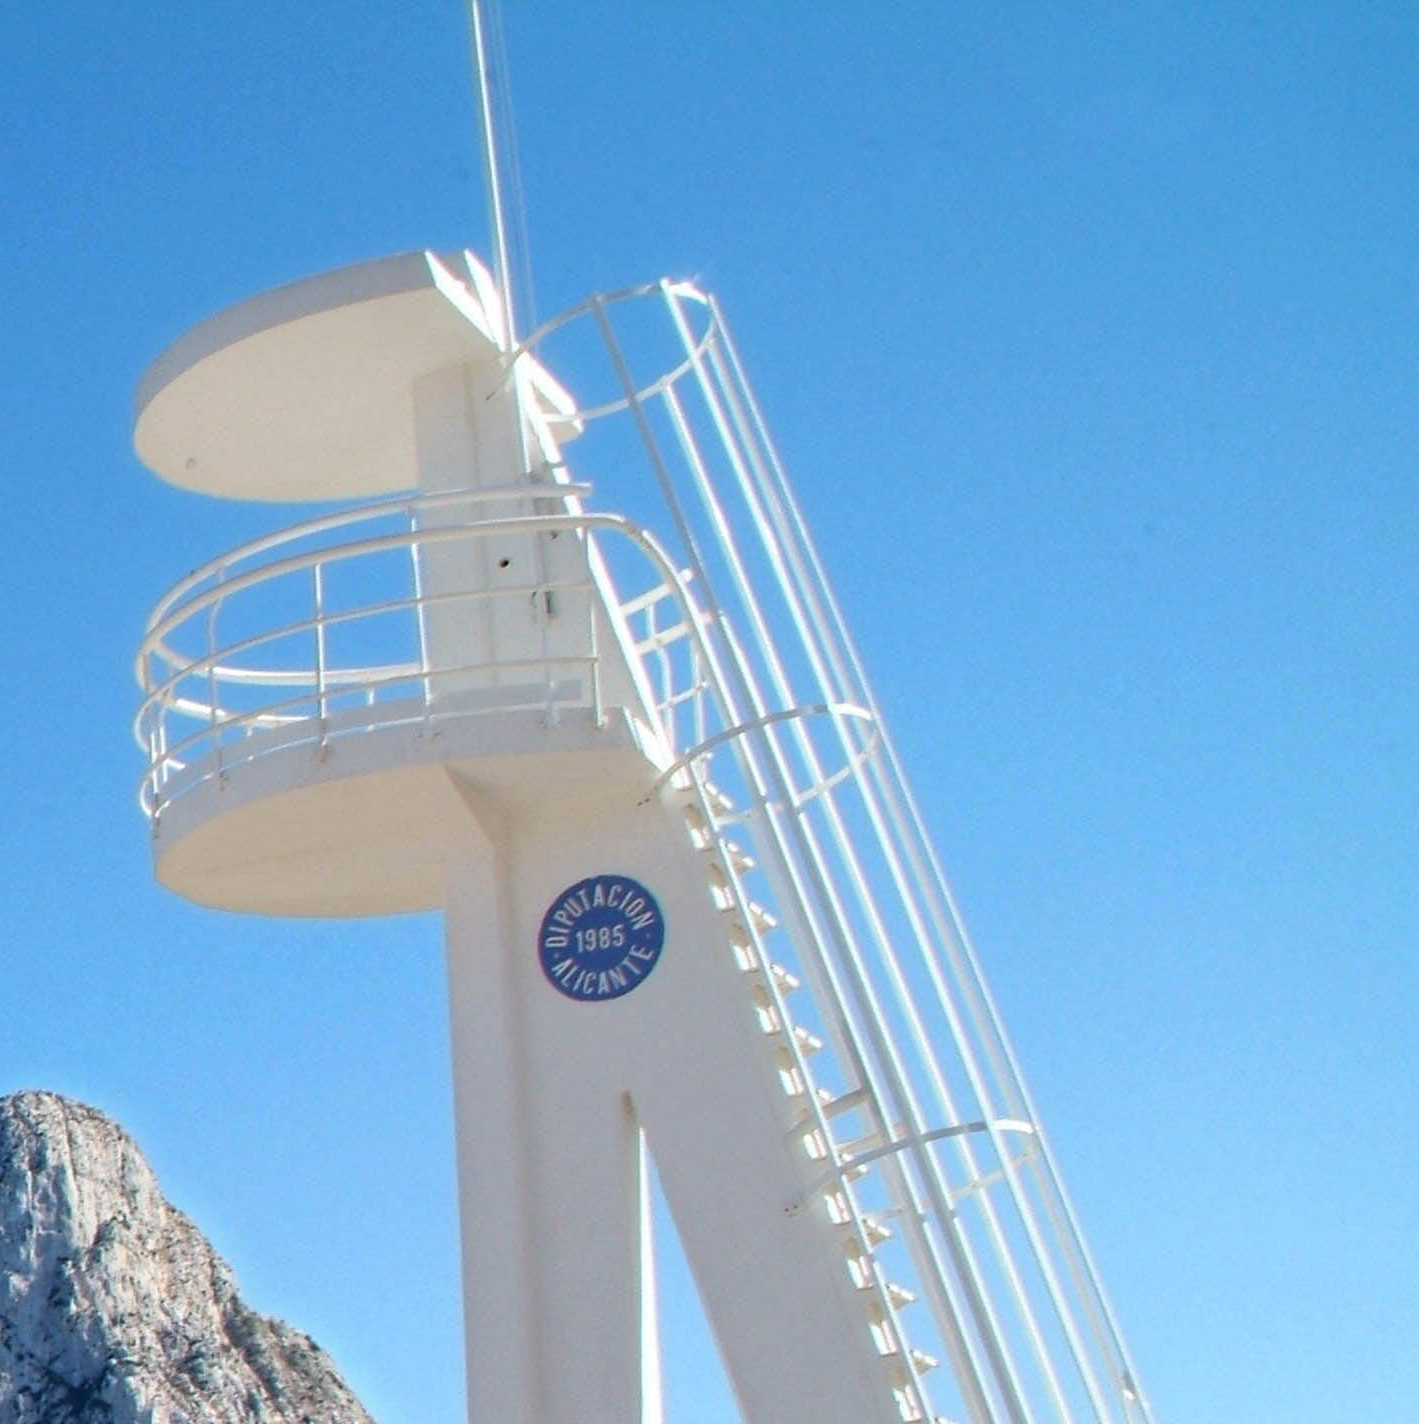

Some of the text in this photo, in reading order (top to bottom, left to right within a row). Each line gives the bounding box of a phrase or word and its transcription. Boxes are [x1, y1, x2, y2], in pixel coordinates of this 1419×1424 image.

[546, 884, 654, 947] DIPUTACION
[577, 925, 625, 952] 1985
[552, 945, 653, 995] ALICANTE
